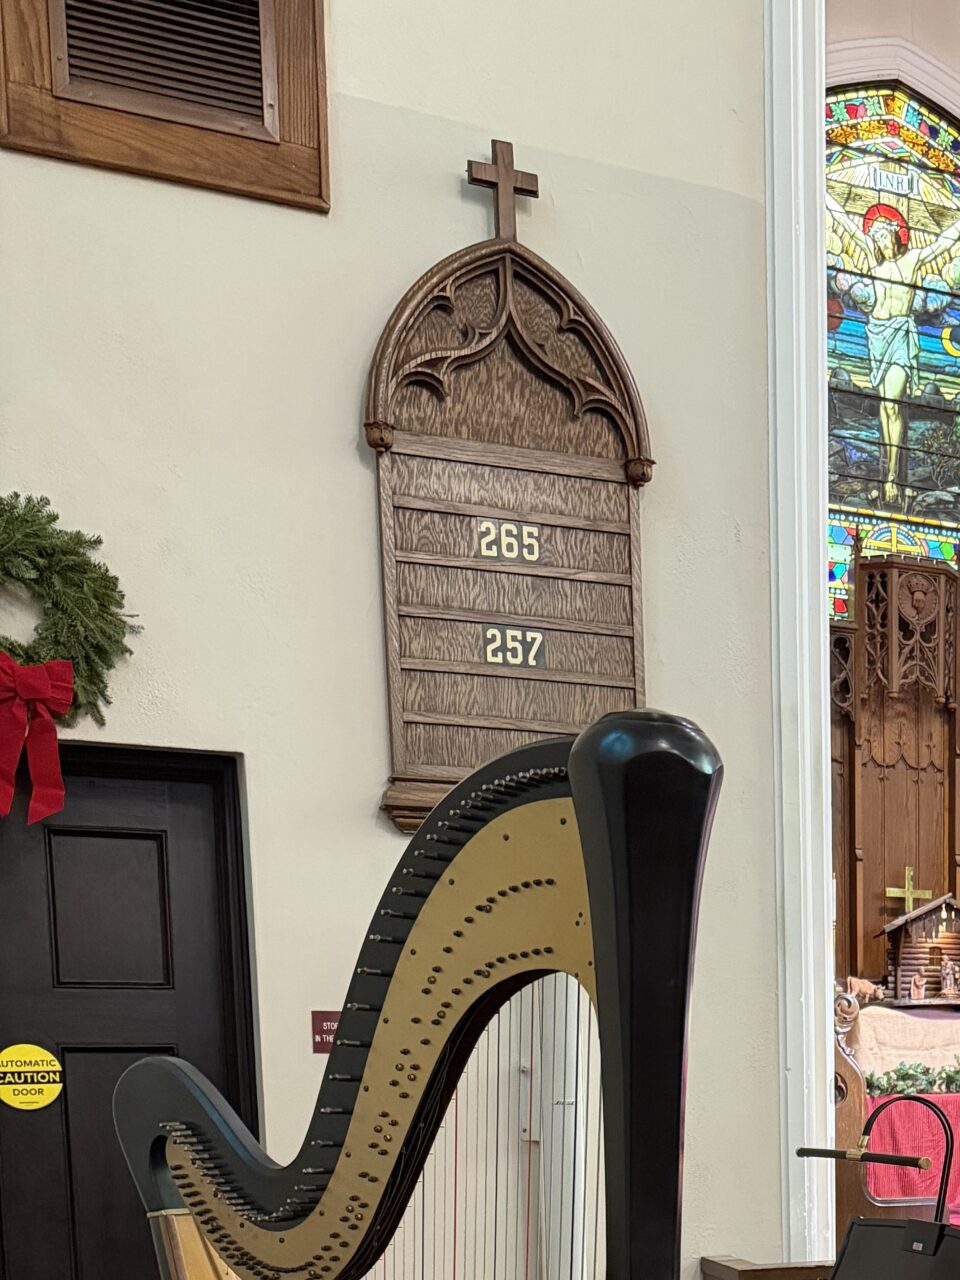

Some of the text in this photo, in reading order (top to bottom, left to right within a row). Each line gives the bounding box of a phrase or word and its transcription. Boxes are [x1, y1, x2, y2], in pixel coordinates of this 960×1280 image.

[480, 521, 539, 561] 265
[486, 628, 543, 666] 257
[0, 1060, 56, 1068] UTOMATIC
[12, 1088, 44, 1096] DOOR
